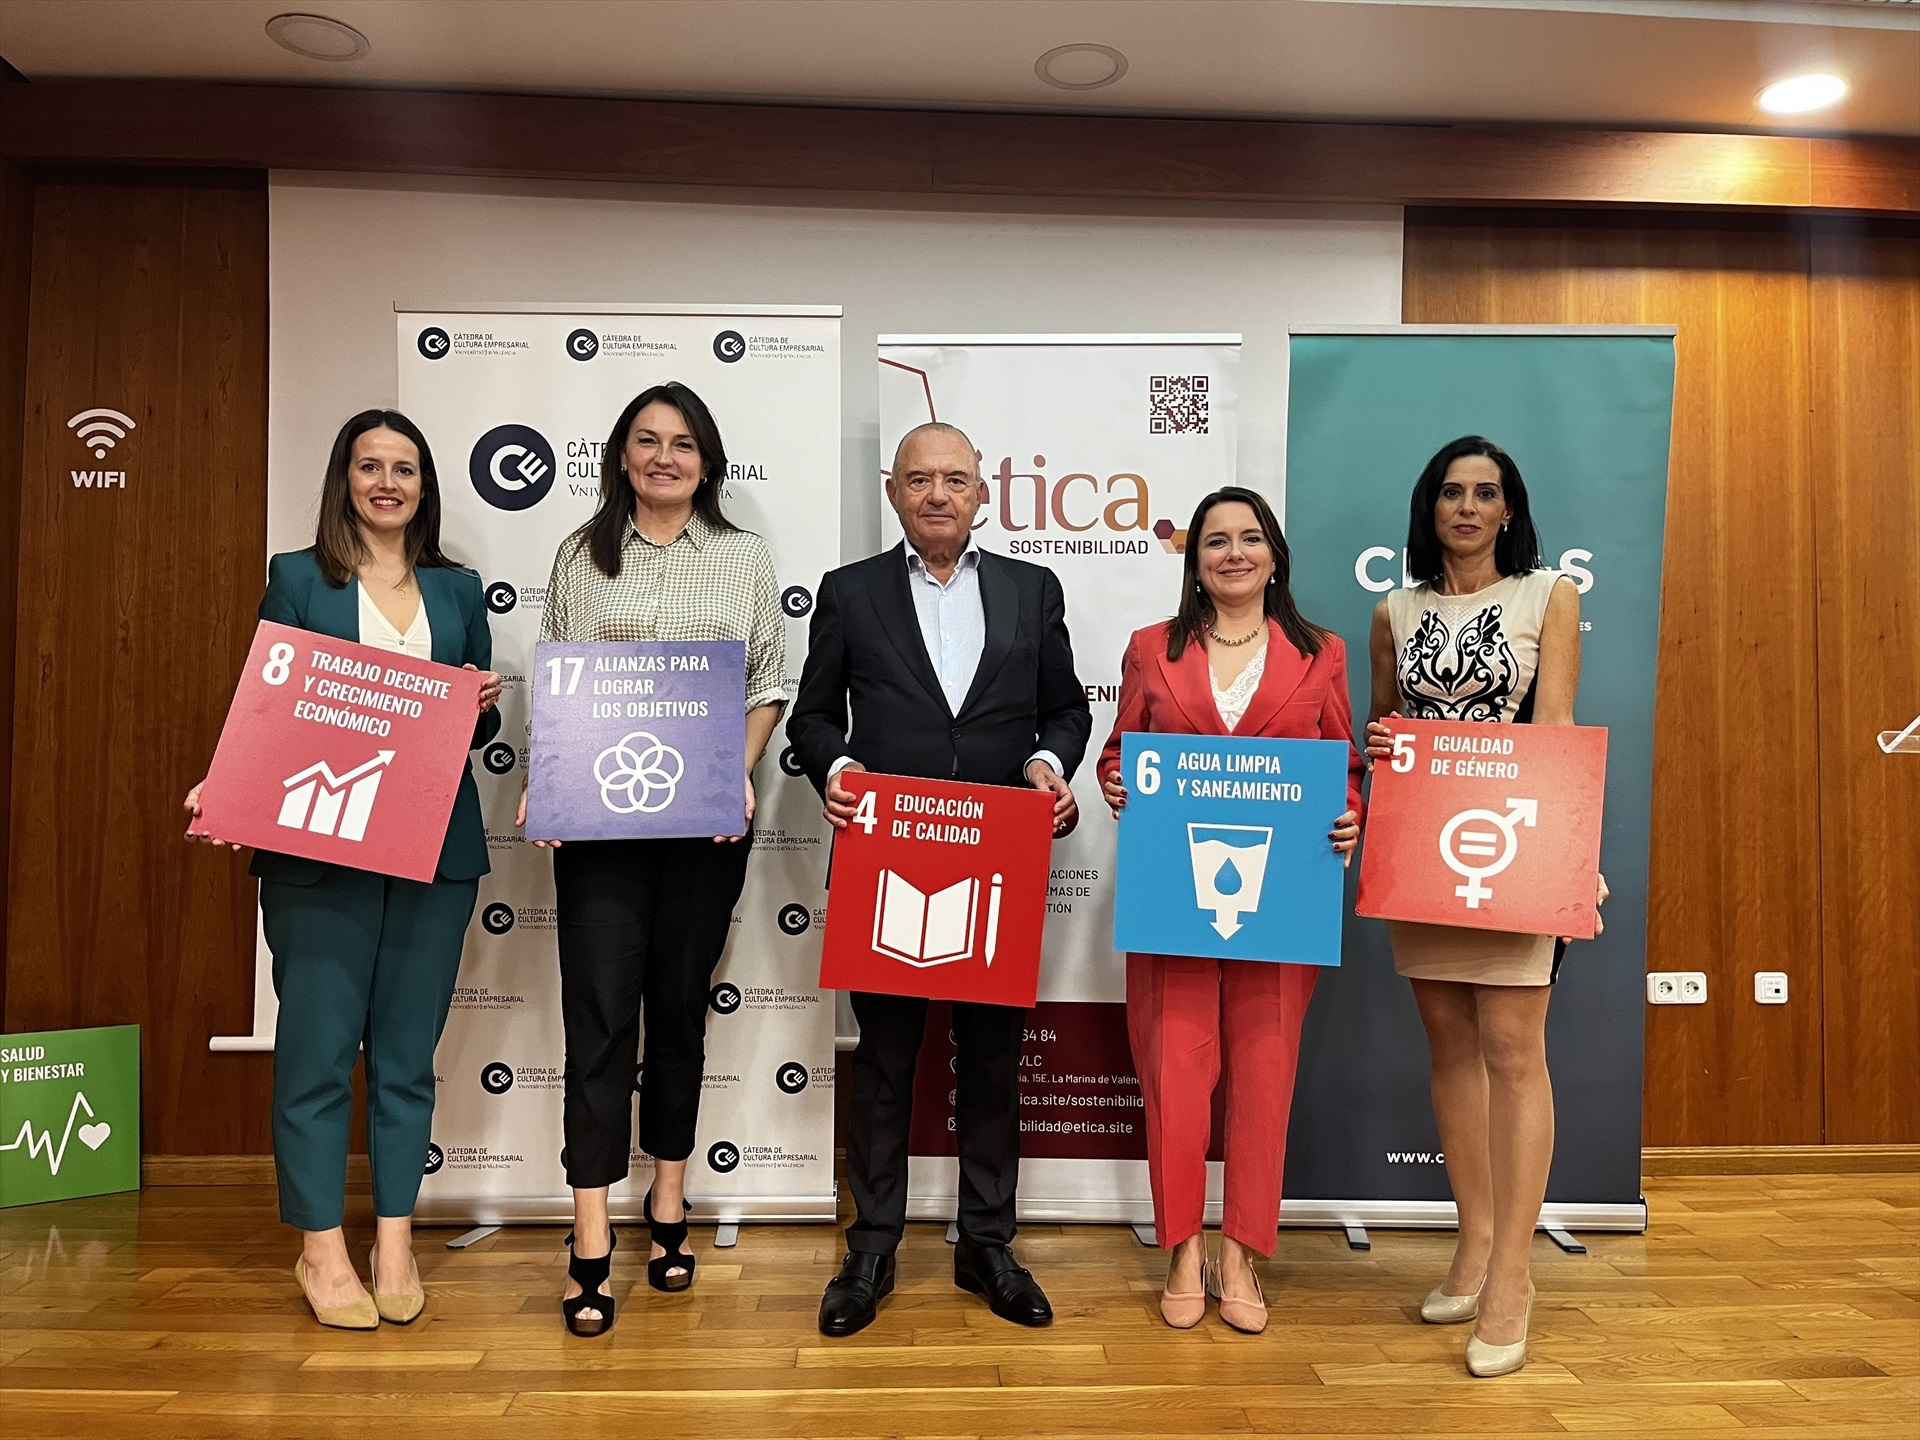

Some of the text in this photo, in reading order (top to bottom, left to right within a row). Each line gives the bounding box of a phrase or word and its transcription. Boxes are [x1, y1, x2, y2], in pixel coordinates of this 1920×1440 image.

[484, 341, 530, 349] EMPRESARIAL
[602, 342, 631, 350] CULTURA
[71, 471, 126, 489] WIFI
[1009, 540, 1149, 555] SOSTENIBILIDAD
[261, 642, 295, 686] 8
[594, 655, 710, 672] ALIANZAS PARA
[311, 650, 451, 700] TRABAJO DECENTE
[546, 657, 585, 696] 17
[303, 674, 423, 719] Y CRECIMIENTO
[593, 679, 655, 695] LOGRAR
[293, 700, 391, 737] ECONÓMICO
[592, 700, 709, 718] LOS OBJETIVOS
[1391, 733, 1416, 773] 5
[1433, 735, 1514, 755] IGUALDAD
[1136, 750, 1161, 795] 6
[1177, 752, 1281, 774] AGUA LIMPIA
[1430, 756, 1519, 779] DE GÉNERO
[1176, 778, 1302, 802] Y SANEAMIENTO
[852, 790, 878, 835] 4
[894, 793, 984, 820] EDUCACIÓN
[892, 819, 981, 845] DE CALIDAD
[1049, 869, 1099, 881] ACIONES
[1076, 887, 1091, 897] DE
[1040, 1029, 1057, 1042] 84
[1, 1046, 44, 1062] SALUD
[1, 1063, 85, 1083] Y BIENESTAR
[1052, 1074, 1064, 1083] La
[1065, 1075, 1096, 1084] Marina
[1098, 1075, 1109, 1084] de
[1020, 1093, 1144, 1107] ica.site/sostenibilid
[1020, 1120, 1133, 1134] bilidad@etica.site
[1386, 1152, 1445, 1164] www.c
